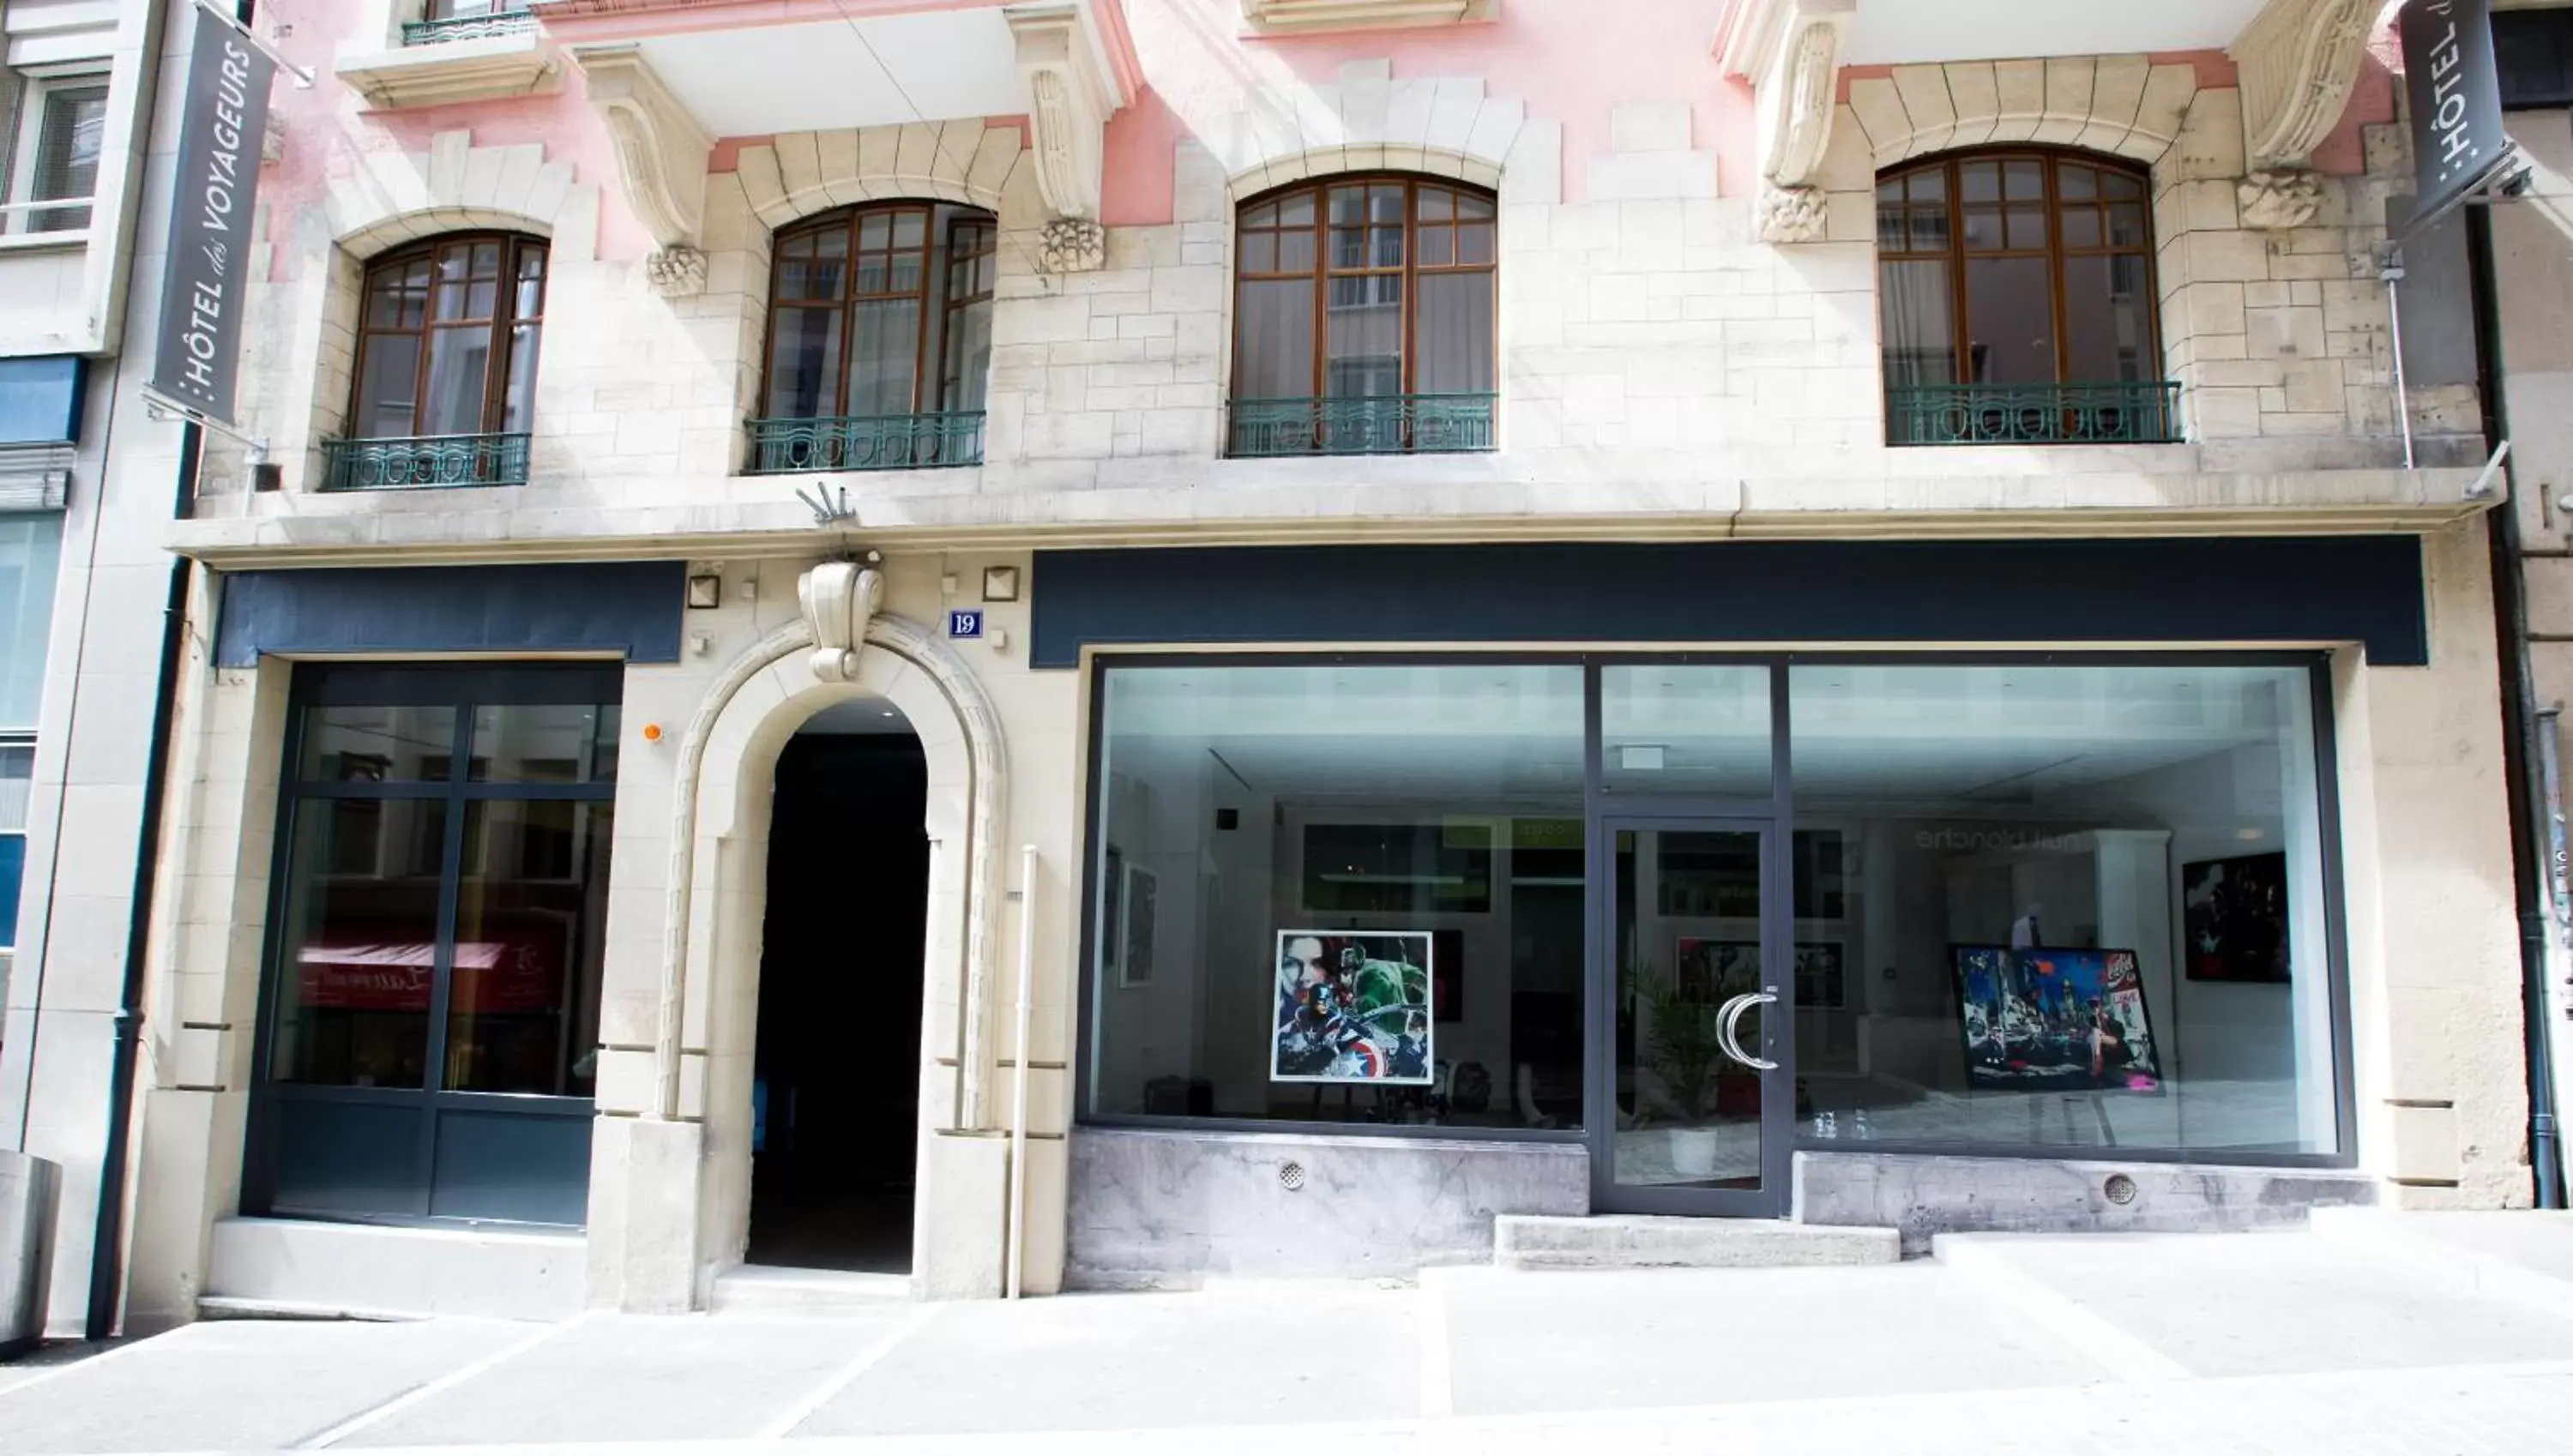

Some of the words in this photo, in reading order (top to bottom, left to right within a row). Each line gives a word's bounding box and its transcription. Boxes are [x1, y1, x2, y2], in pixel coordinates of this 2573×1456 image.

[202, 40, 250, 231] VOYAGEURS
[2429, 21, 2471, 163] HÔTEL
[202, 236, 228, 277] des
[182, 280, 223, 387] HÔTEL
[955, 614, 975, 634] 19
